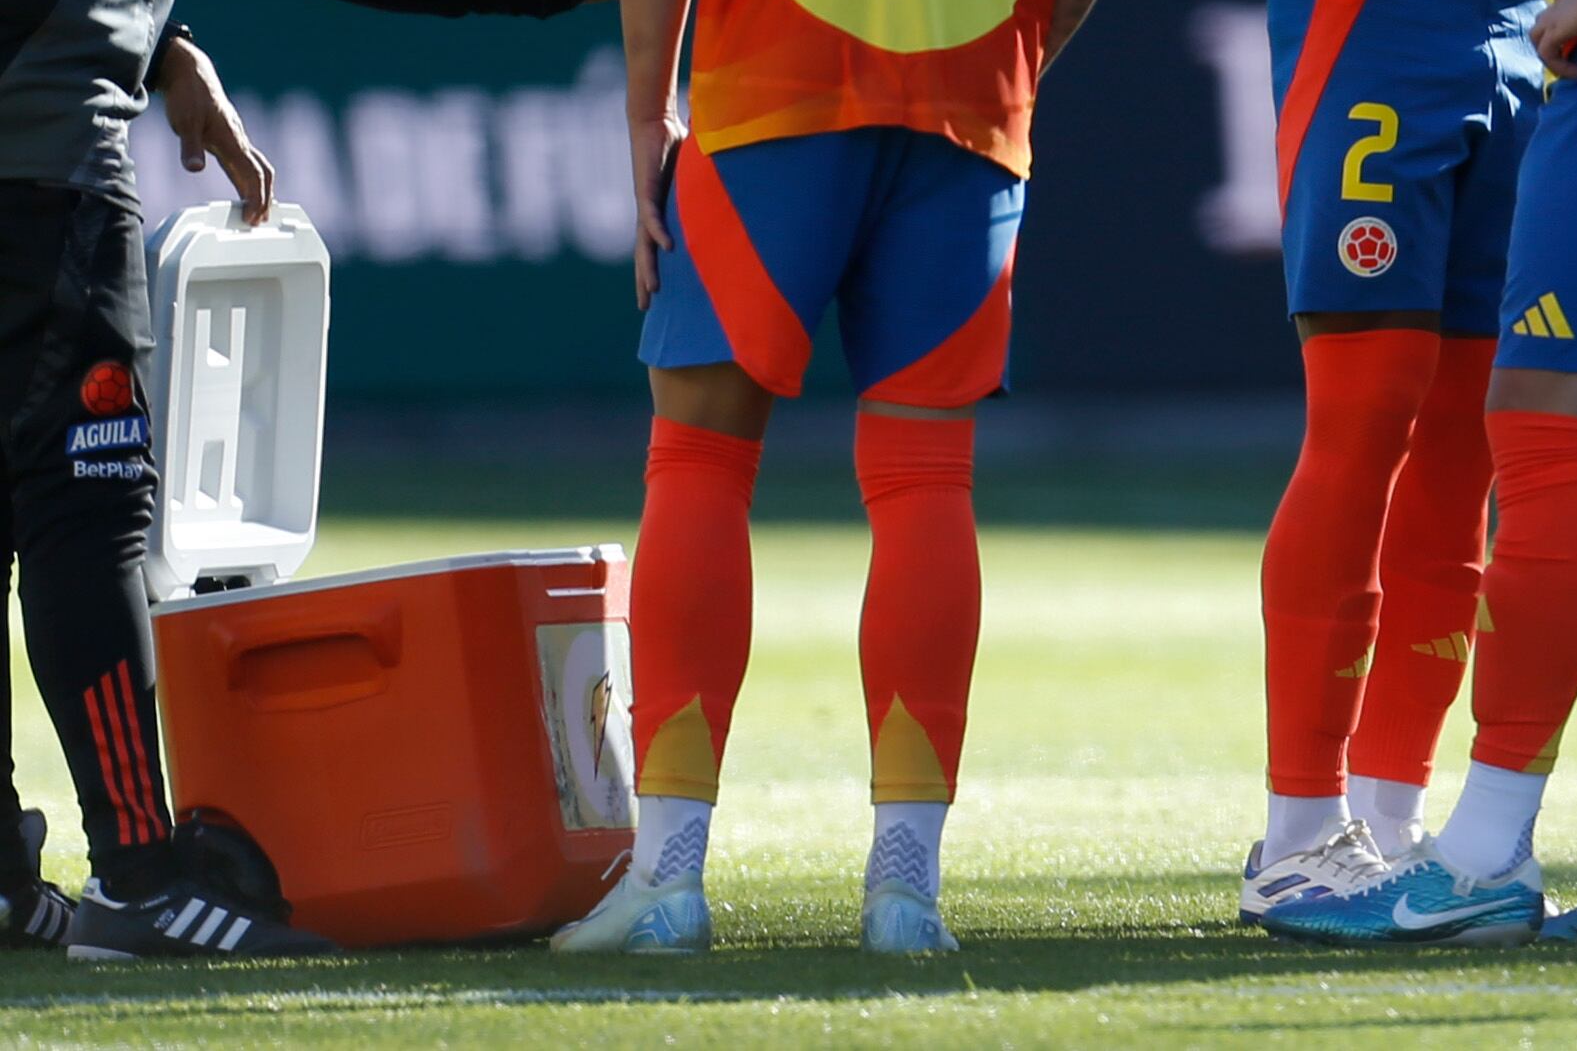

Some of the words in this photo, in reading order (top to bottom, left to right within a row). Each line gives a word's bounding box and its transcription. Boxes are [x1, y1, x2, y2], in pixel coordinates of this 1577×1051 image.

[1340, 101, 1400, 203] 2
[71, 419, 142, 452] AGUILA
[74, 460, 144, 481] BetPlay
